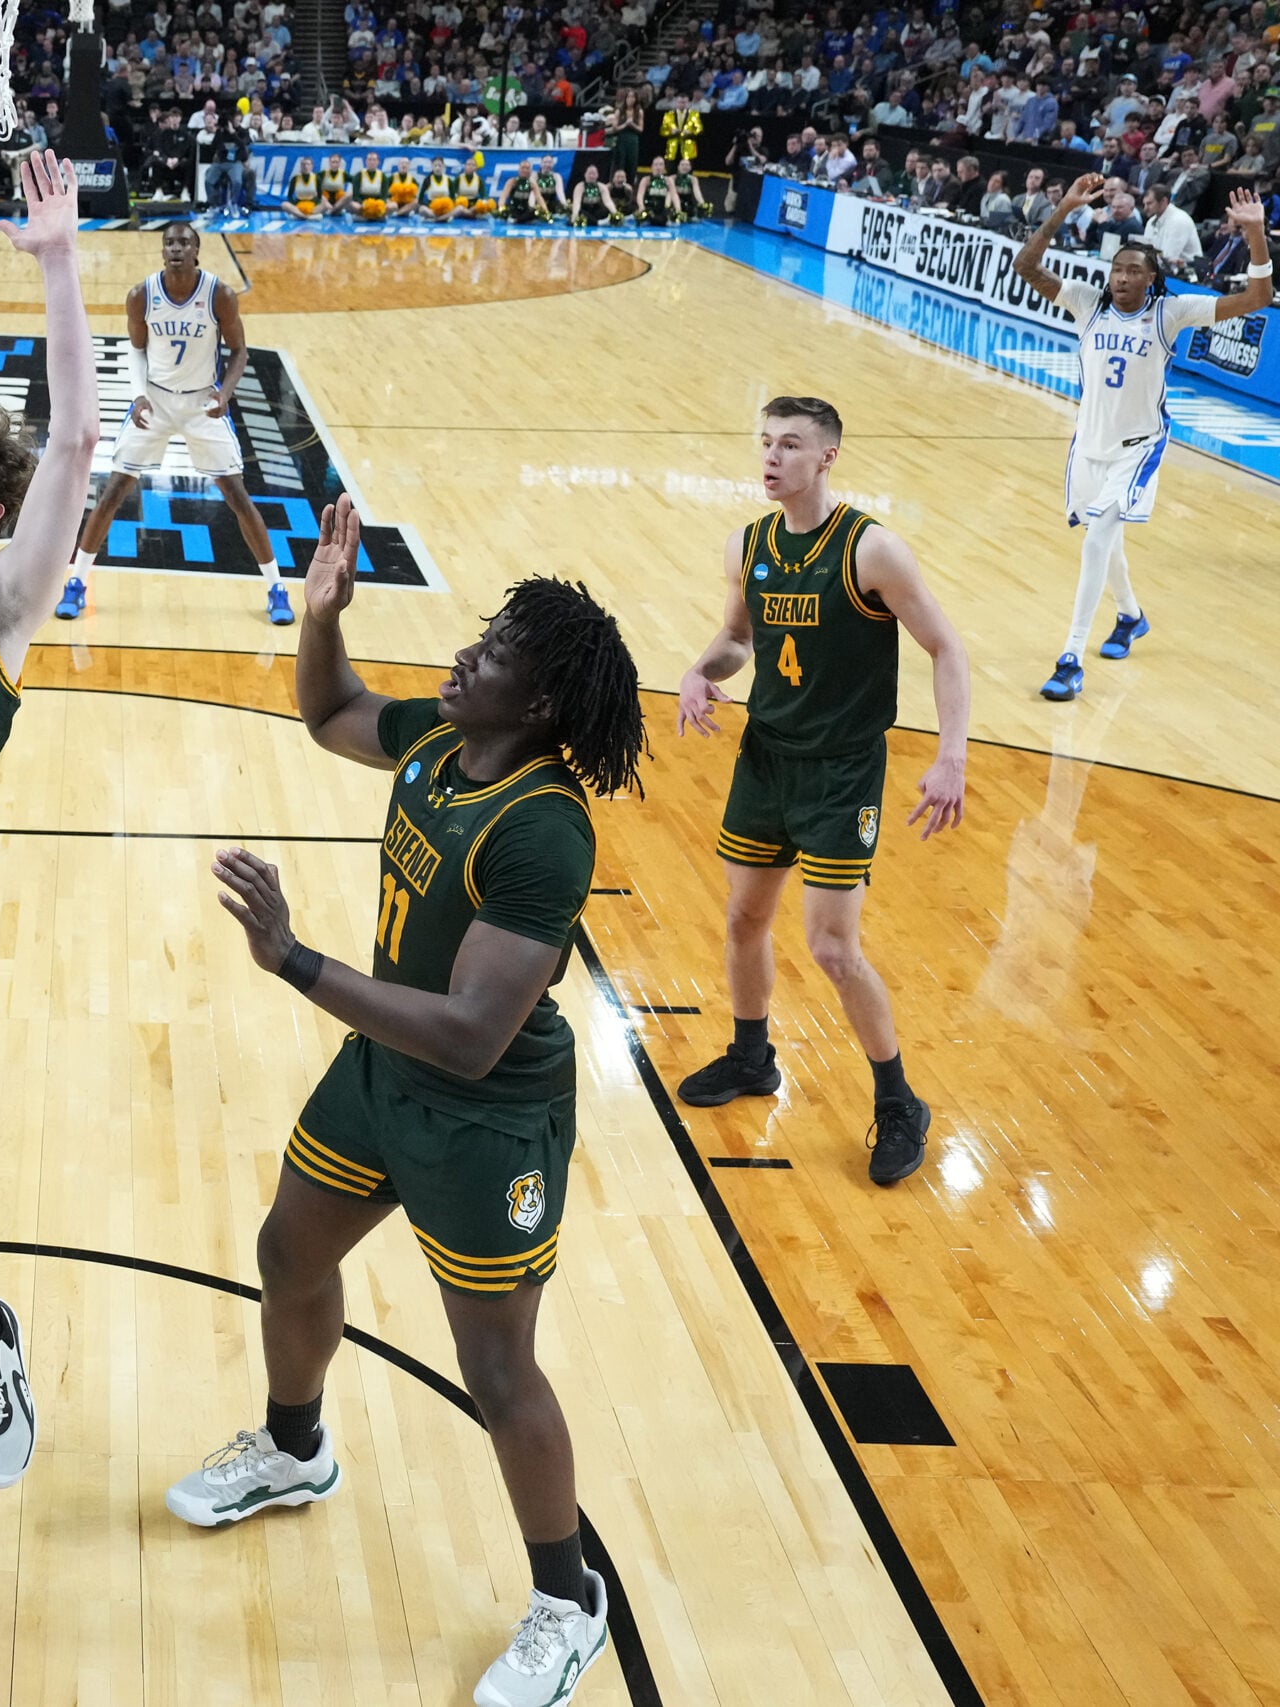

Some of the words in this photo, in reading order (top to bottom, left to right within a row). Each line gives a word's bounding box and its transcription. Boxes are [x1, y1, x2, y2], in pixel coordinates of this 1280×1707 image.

[860, 206, 905, 264] FIRST
[899, 232, 917, 255] AND
[915, 223, 993, 292] SECOND
[150, 320, 207, 338] DUKE
[1094, 333, 1153, 358] DUKE
[170, 340, 187, 365] 7
[1209, 333, 1259, 369] MADNESS
[1105, 356, 1127, 389] 3
[763, 595, 818, 624] SIENA
[777, 633, 803, 686] 4
[384, 815, 438, 890] SIENA
[376, 872, 410, 965] 11
